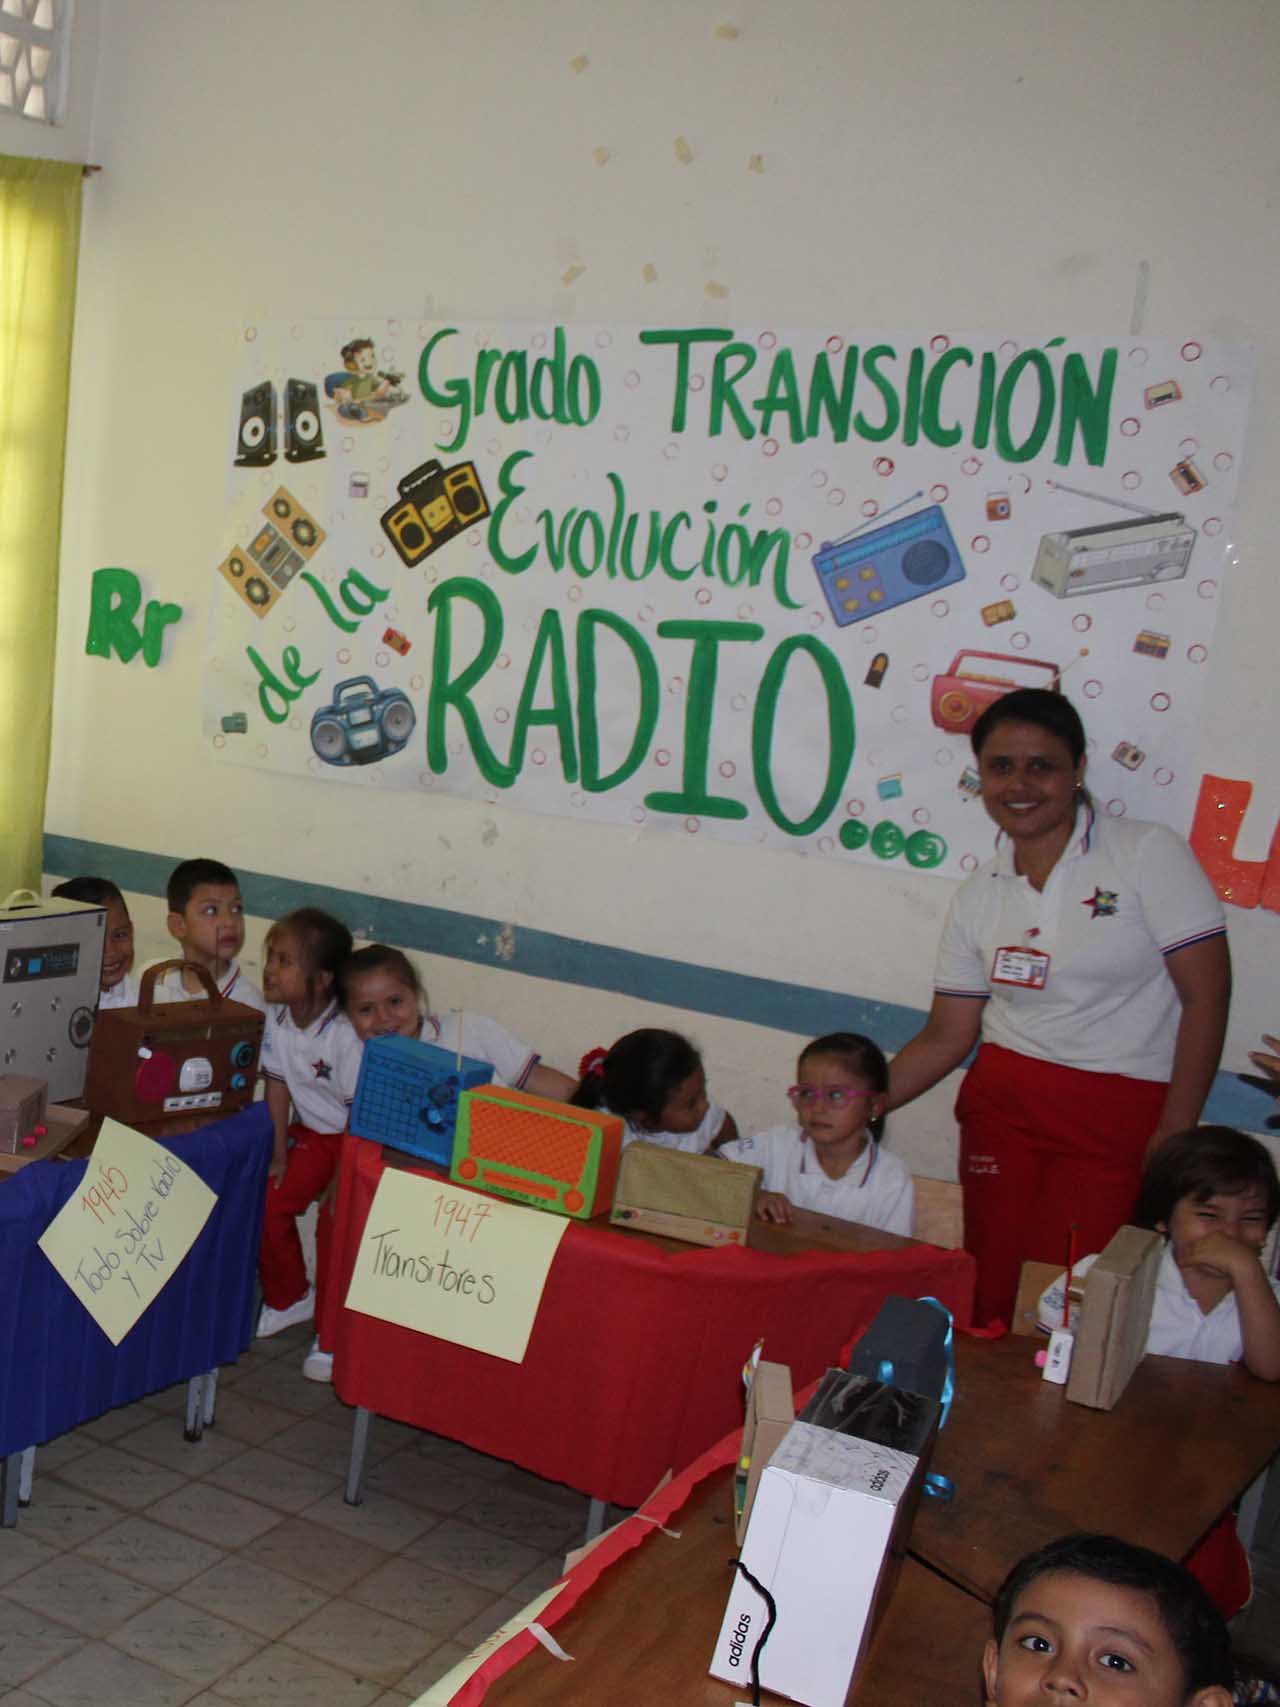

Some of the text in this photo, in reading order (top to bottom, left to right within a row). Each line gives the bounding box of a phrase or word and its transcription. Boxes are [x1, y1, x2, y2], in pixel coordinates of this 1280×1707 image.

[419, 326, 1117, 466] Grado TRANSICIÓN
[488, 450, 805, 609] Evolución
[85, 567, 182, 667] Rr
[246, 567, 391, 724] de la
[82, 1163, 129, 1225] 1945
[433, 1193, 492, 1243] 1947
[74, 1247, 121, 1295] Todo
[370, 1228, 496, 1305] Transitores
[728, 1613, 752, 1667] adidas
